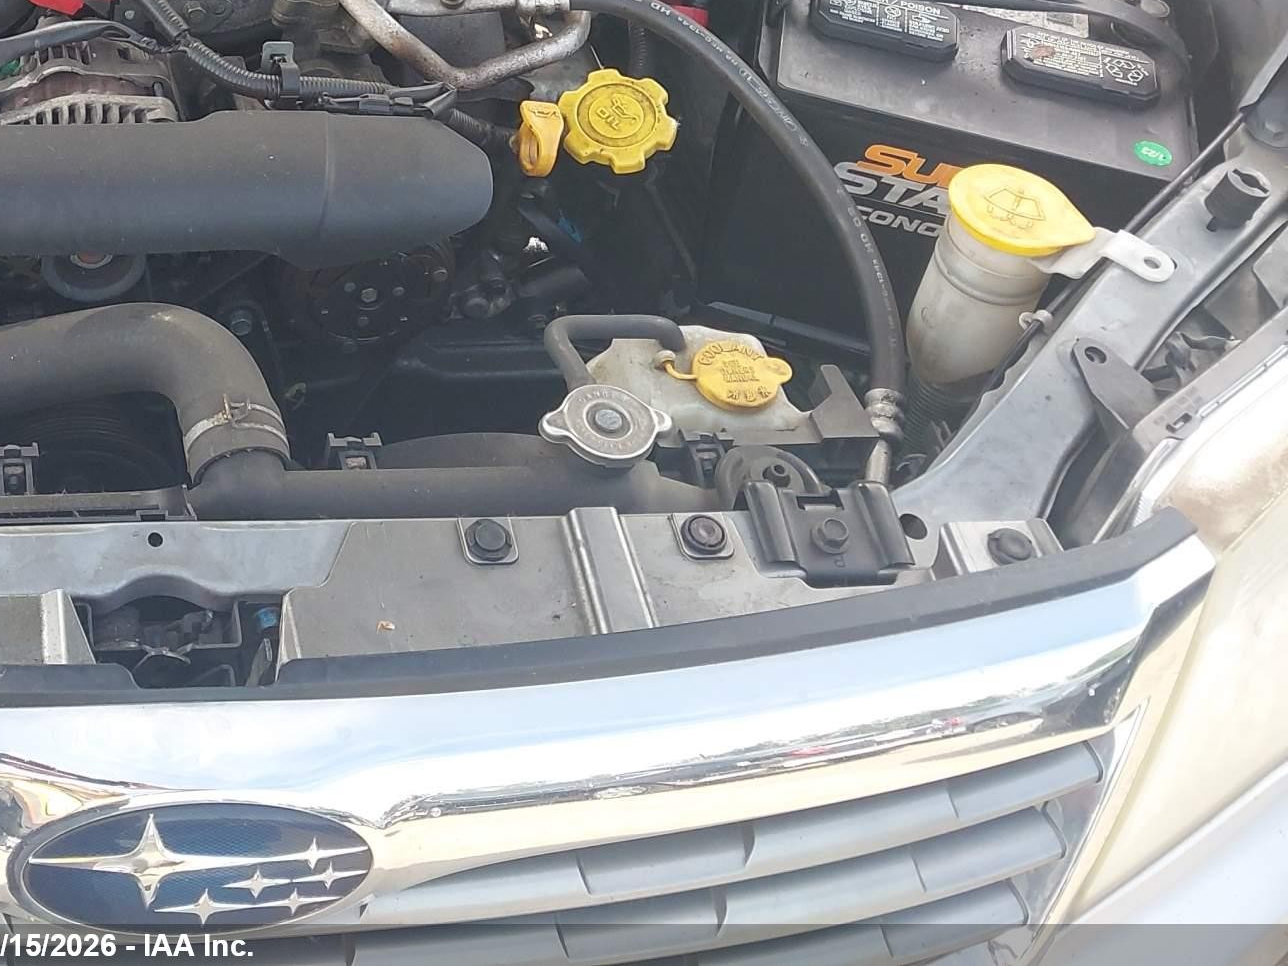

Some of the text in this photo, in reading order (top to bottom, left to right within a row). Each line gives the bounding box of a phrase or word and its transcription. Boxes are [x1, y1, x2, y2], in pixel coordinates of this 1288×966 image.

[900, 0, 941, 15] POISON
[595, 106, 620, 131] OIL
[697, 342, 765, 366] COOLANT
